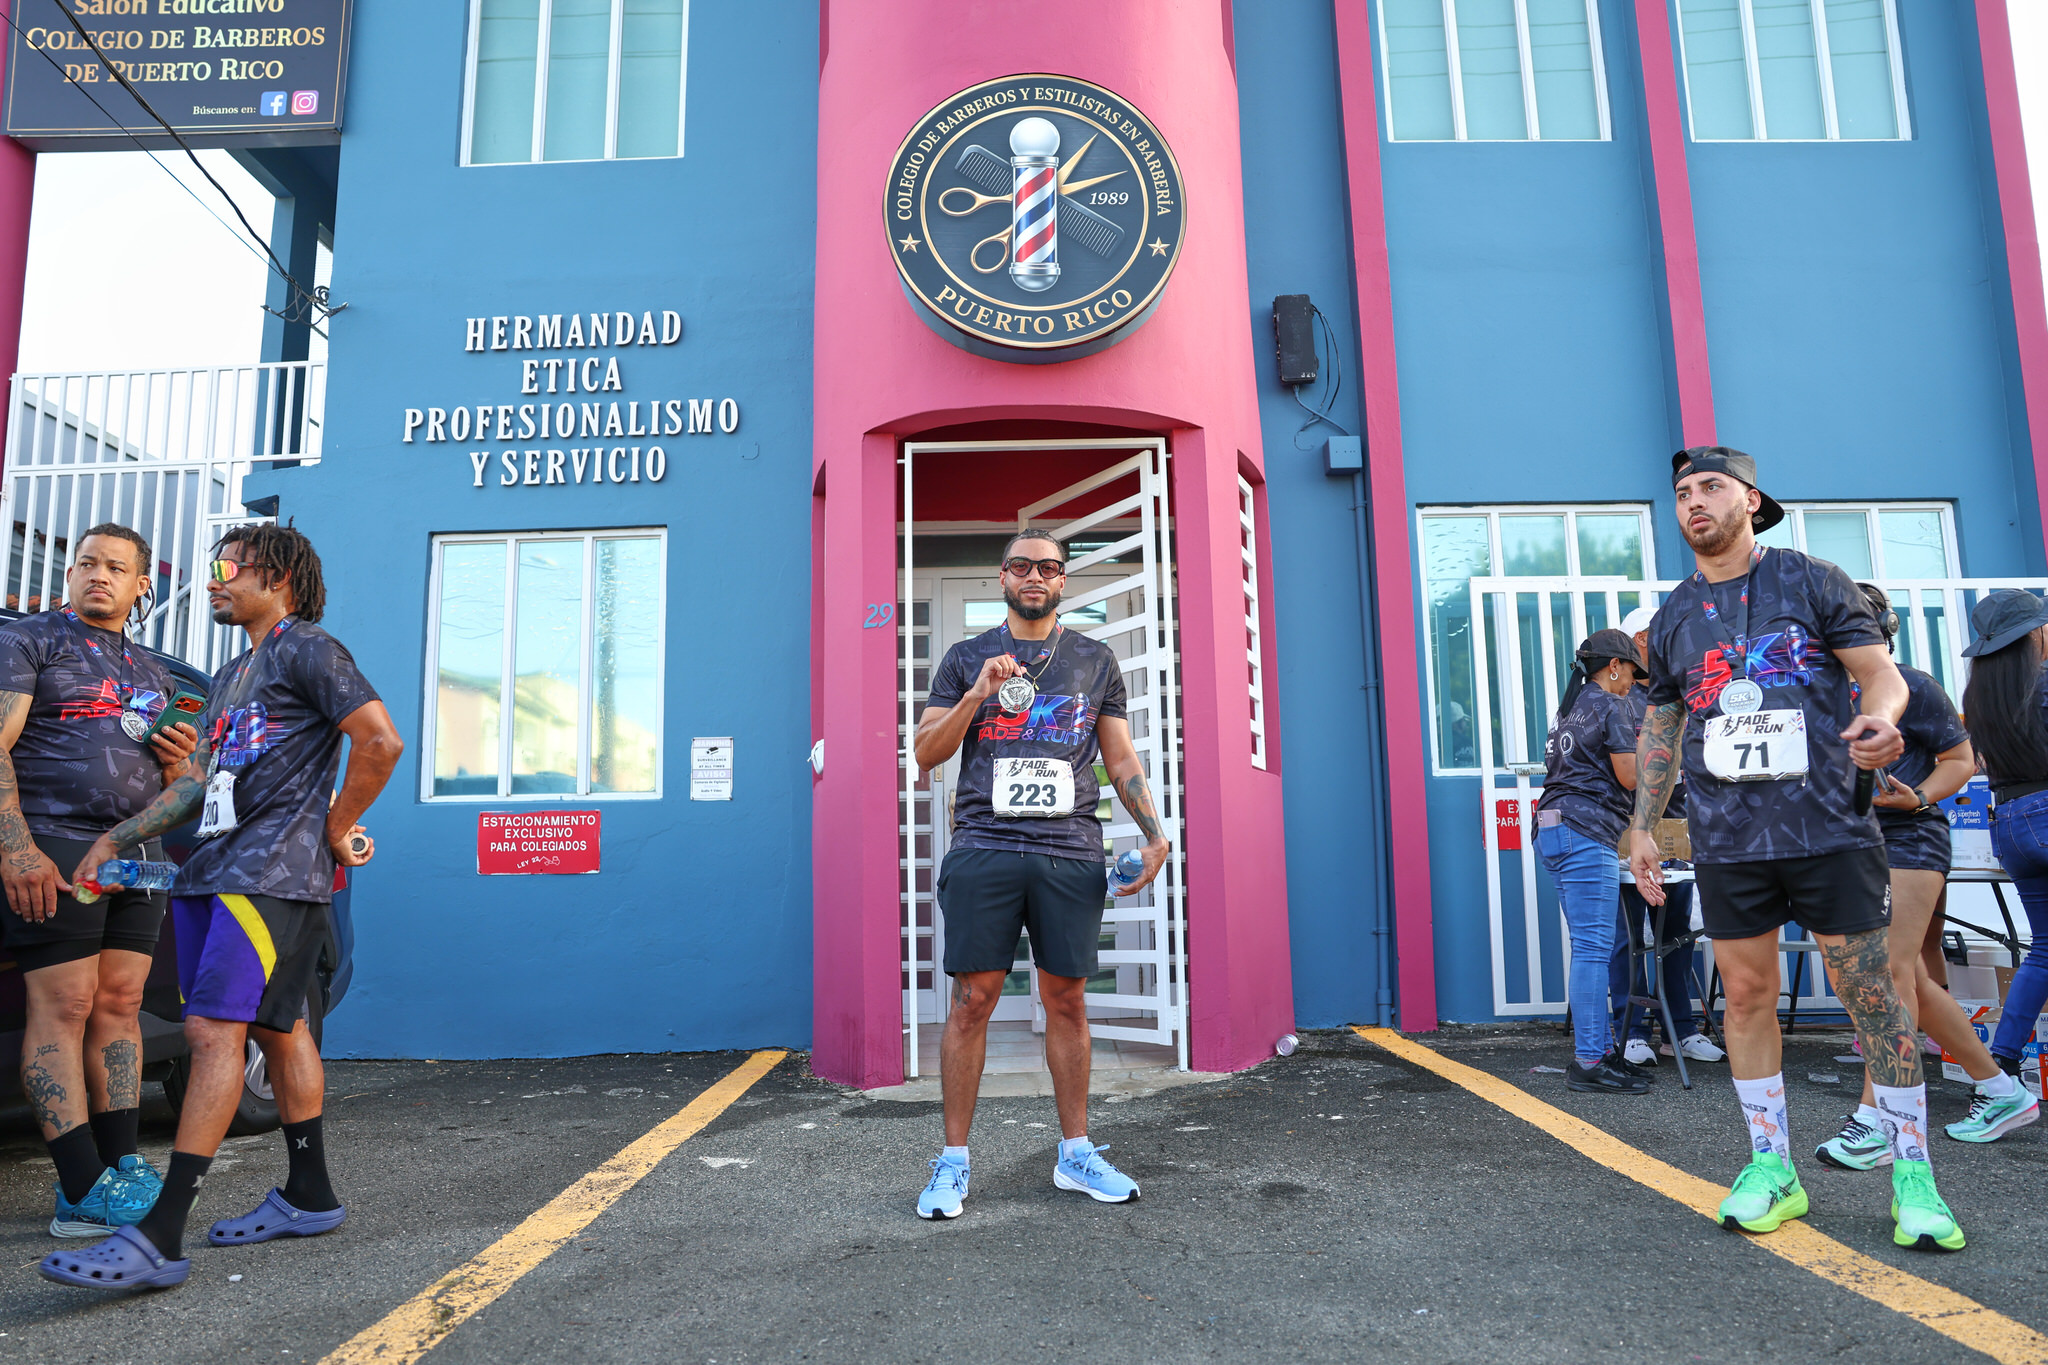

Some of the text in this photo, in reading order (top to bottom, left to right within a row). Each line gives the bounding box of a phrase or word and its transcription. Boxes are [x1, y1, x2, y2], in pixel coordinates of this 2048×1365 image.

[158, 0, 285, 15] Educativo
[26, 26, 326, 51] COLEGIO DE BARBEROS
[63, 58, 284, 84] DE PUERTO RICO
[192, 105, 239, 115] Búscanos
[241, 106, 257, 114] en:
[897, 87, 1174, 221] COLEGIO DE BARBEROS Y ESTILISTAS EN BARBERÍA
[1088, 191, 1129, 206] 1989
[934, 284, 1133, 334] PUERTO RICO
[464, 310, 682, 351] HERMANDAD
[520, 356, 623, 394] ETICA
[402, 397, 740, 443] PROFESIONALISMO
[469, 446, 666, 487] Y SERVICIO
[863, 603, 894, 629] 29
[1736, 713, 1772, 727] FADE
[1754, 723, 1785, 735] RUN
[1036, 728, 1080, 747] RUN
[1021, 760, 1050, 770] FADE
[1733, 741, 1770, 770] 71
[1034, 769, 1059, 778] RUN
[1008, 783, 1057, 807] 223
[482, 814, 596, 828] ESTACIONAMIENTO
[504, 827, 573, 839] EXCLUSIVO
[490, 840, 587, 852] PARA COLEGIADOS
[516, 860, 530, 869] LEY
